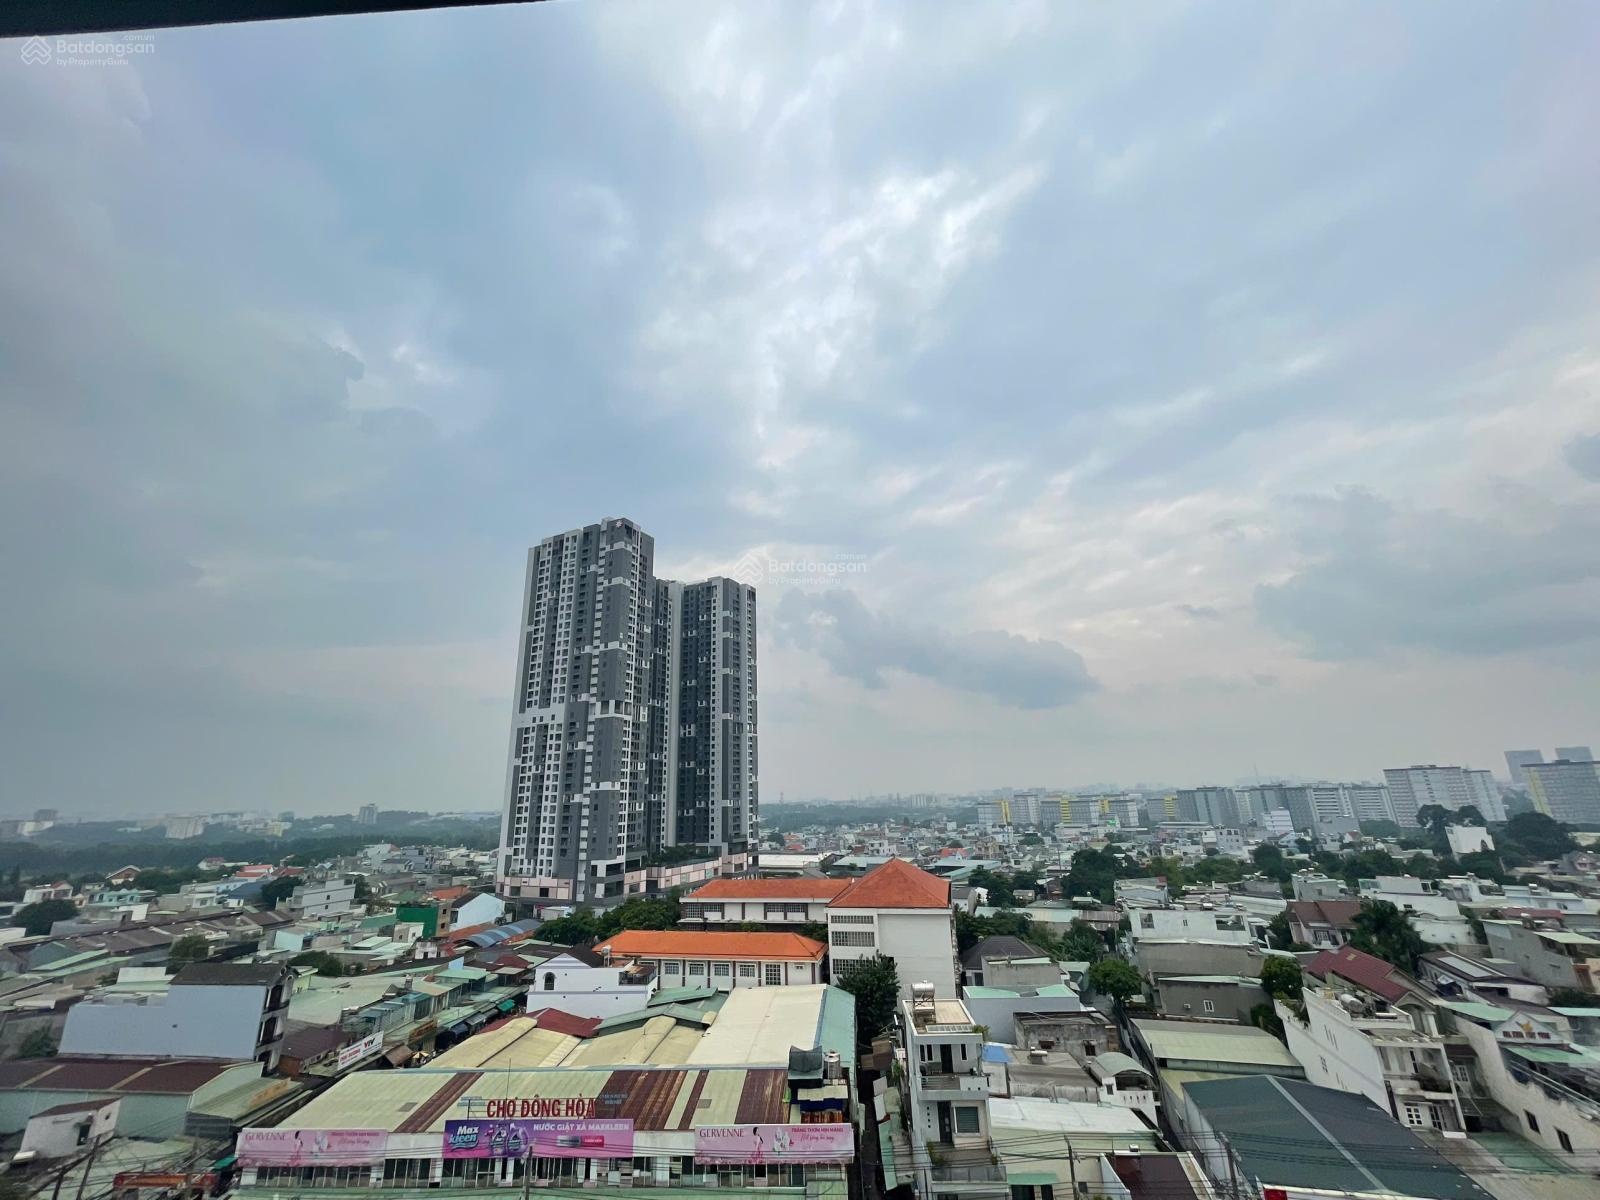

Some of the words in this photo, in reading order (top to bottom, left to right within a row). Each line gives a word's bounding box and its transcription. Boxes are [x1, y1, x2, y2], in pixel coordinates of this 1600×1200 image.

[457, 1125, 479, 1135] Max
[533, 1123, 556, 1131] NƯỚC
[245, 1132, 286, 1141] GERVENNE
[700, 1128, 745, 1138] GERVENNE
